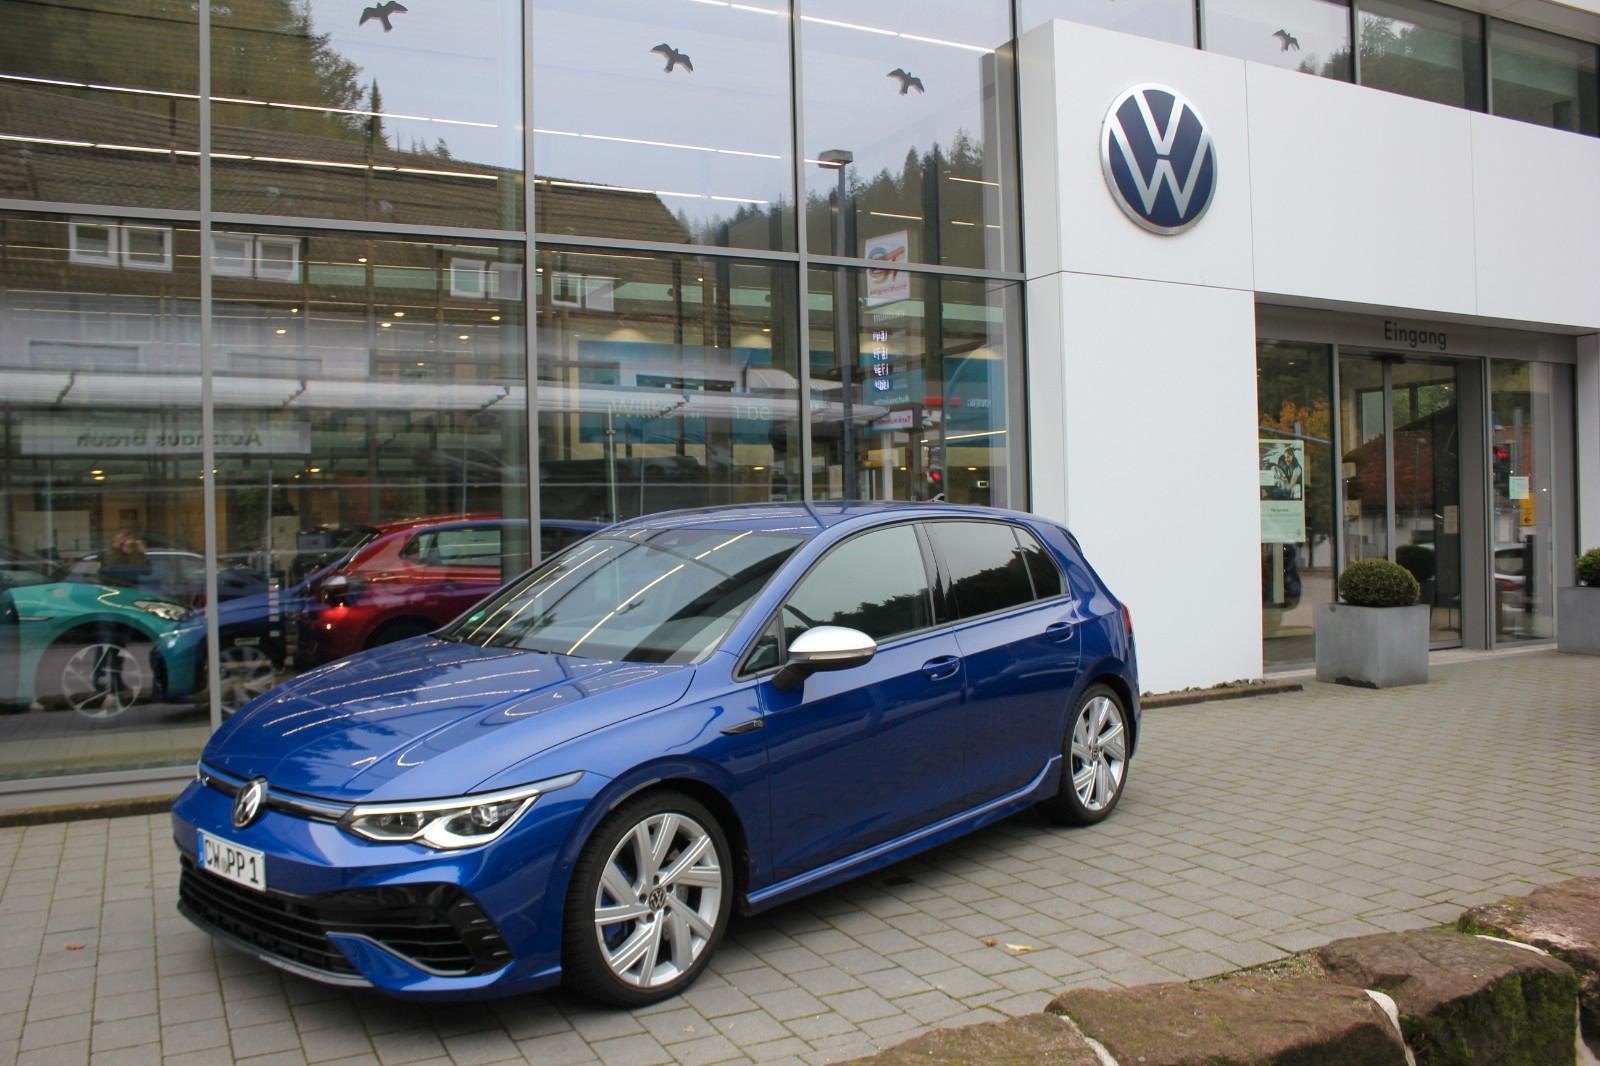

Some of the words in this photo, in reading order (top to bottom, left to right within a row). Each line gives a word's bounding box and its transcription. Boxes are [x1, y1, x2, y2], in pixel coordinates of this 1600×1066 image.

[1101, 83, 1218, 236] VW
[1384, 320, 1447, 351] Eingang
[205, 839, 221, 867] CW
[226, 847, 245, 878] PP
[249, 856, 259, 885] 1
